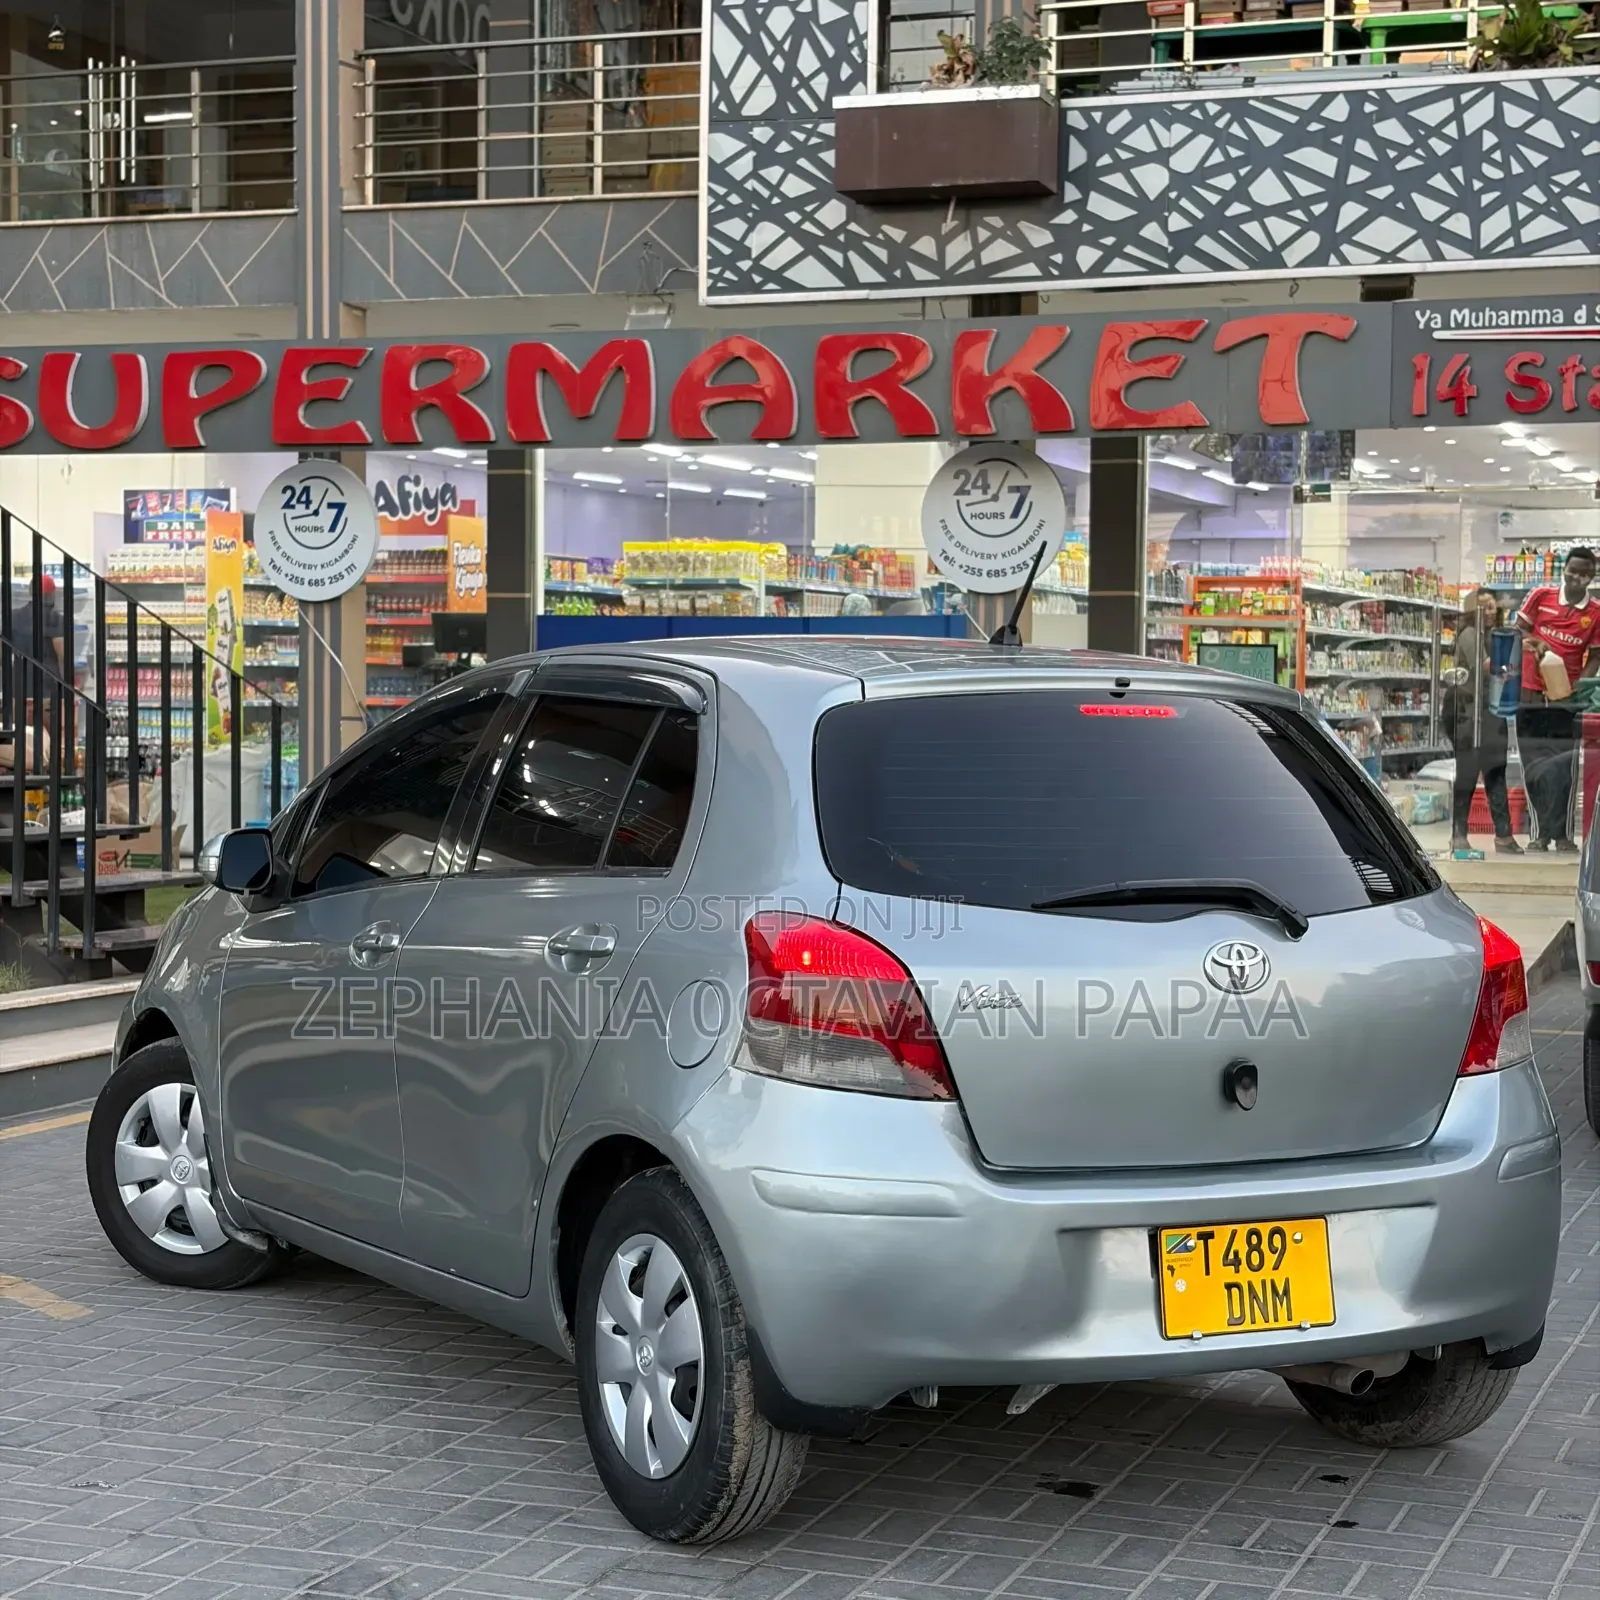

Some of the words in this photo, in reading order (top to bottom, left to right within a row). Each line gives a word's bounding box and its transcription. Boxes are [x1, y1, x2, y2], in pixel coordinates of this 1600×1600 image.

[1414, 309, 1442, 330] Ya
[1411, 352, 1477, 417] 14
[374, 474, 459, 523] Afiya
[953, 468, 991, 496] 24
[1007, 485, 1032, 519] 7
[281, 485, 313, 510] 24
[326, 502, 348, 533] 7
[970, 511, 1006, 521] HOURS
[156, 521, 195, 531] DAR
[294, 525, 325, 534] HOURS
[938, 518, 955, 542] FREE
[954, 540, 999, 560] DELIVERY
[1001, 518, 1047, 559] KIGAMBONI
[268, 530, 281, 553] FREE
[281, 551, 318, 571] DELIVERY
[320, 534, 359, 570] KIGAMBONI
[938, 549, 956, 567] Tel:
[958, 563, 983, 578] +255
[986, 568, 1008, 579] 685
[1010, 561, 1030, 576] 255
[268, 558, 283, 575] Tel:
[284, 572, 305, 586] +255
[307, 578, 326, 587] 685
[327, 571, 345, 585] 255
[1539, 626, 1583, 646] SHARP
[1204, 647, 1269, 665] OPEN
[957, 984, 1023, 1012] Vitz
[1223, 1277, 1293, 1327] DNM
